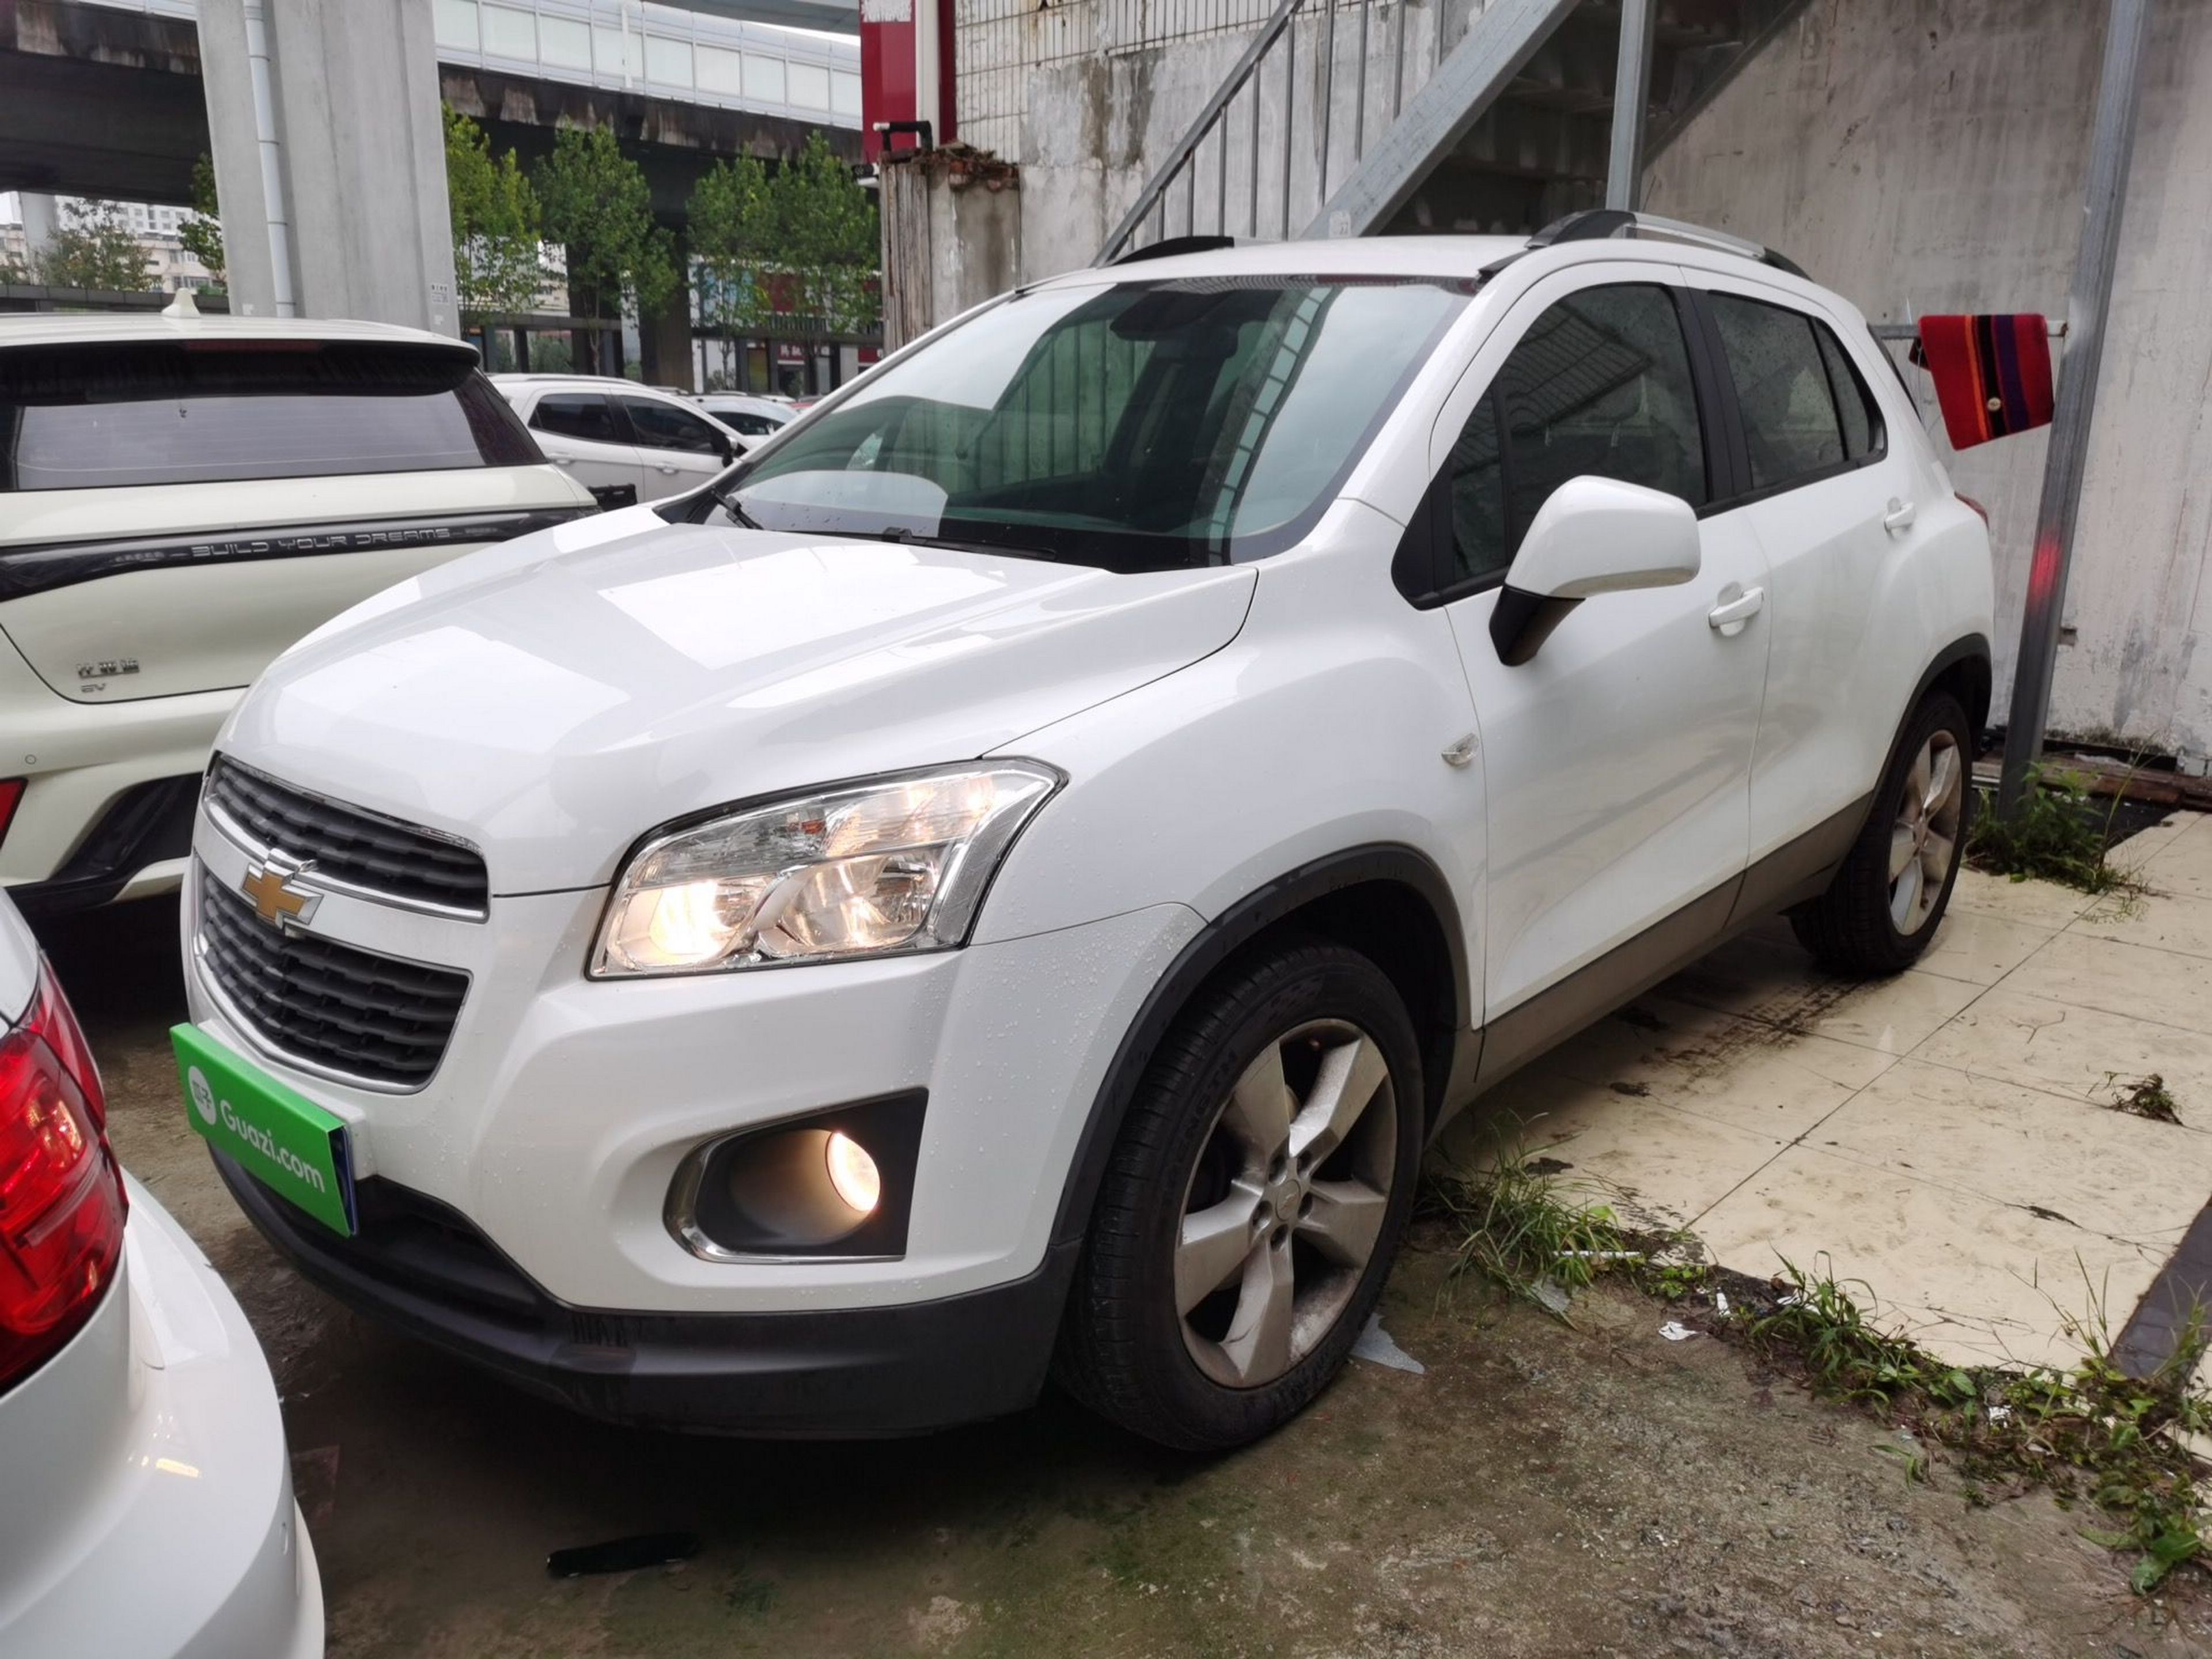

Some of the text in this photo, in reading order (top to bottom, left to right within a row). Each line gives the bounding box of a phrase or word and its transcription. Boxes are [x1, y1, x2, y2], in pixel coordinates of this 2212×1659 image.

[191, 528, 450, 556] BUILD YOUR DREAMS
[219, 1099, 325, 1194] Guazi.com
